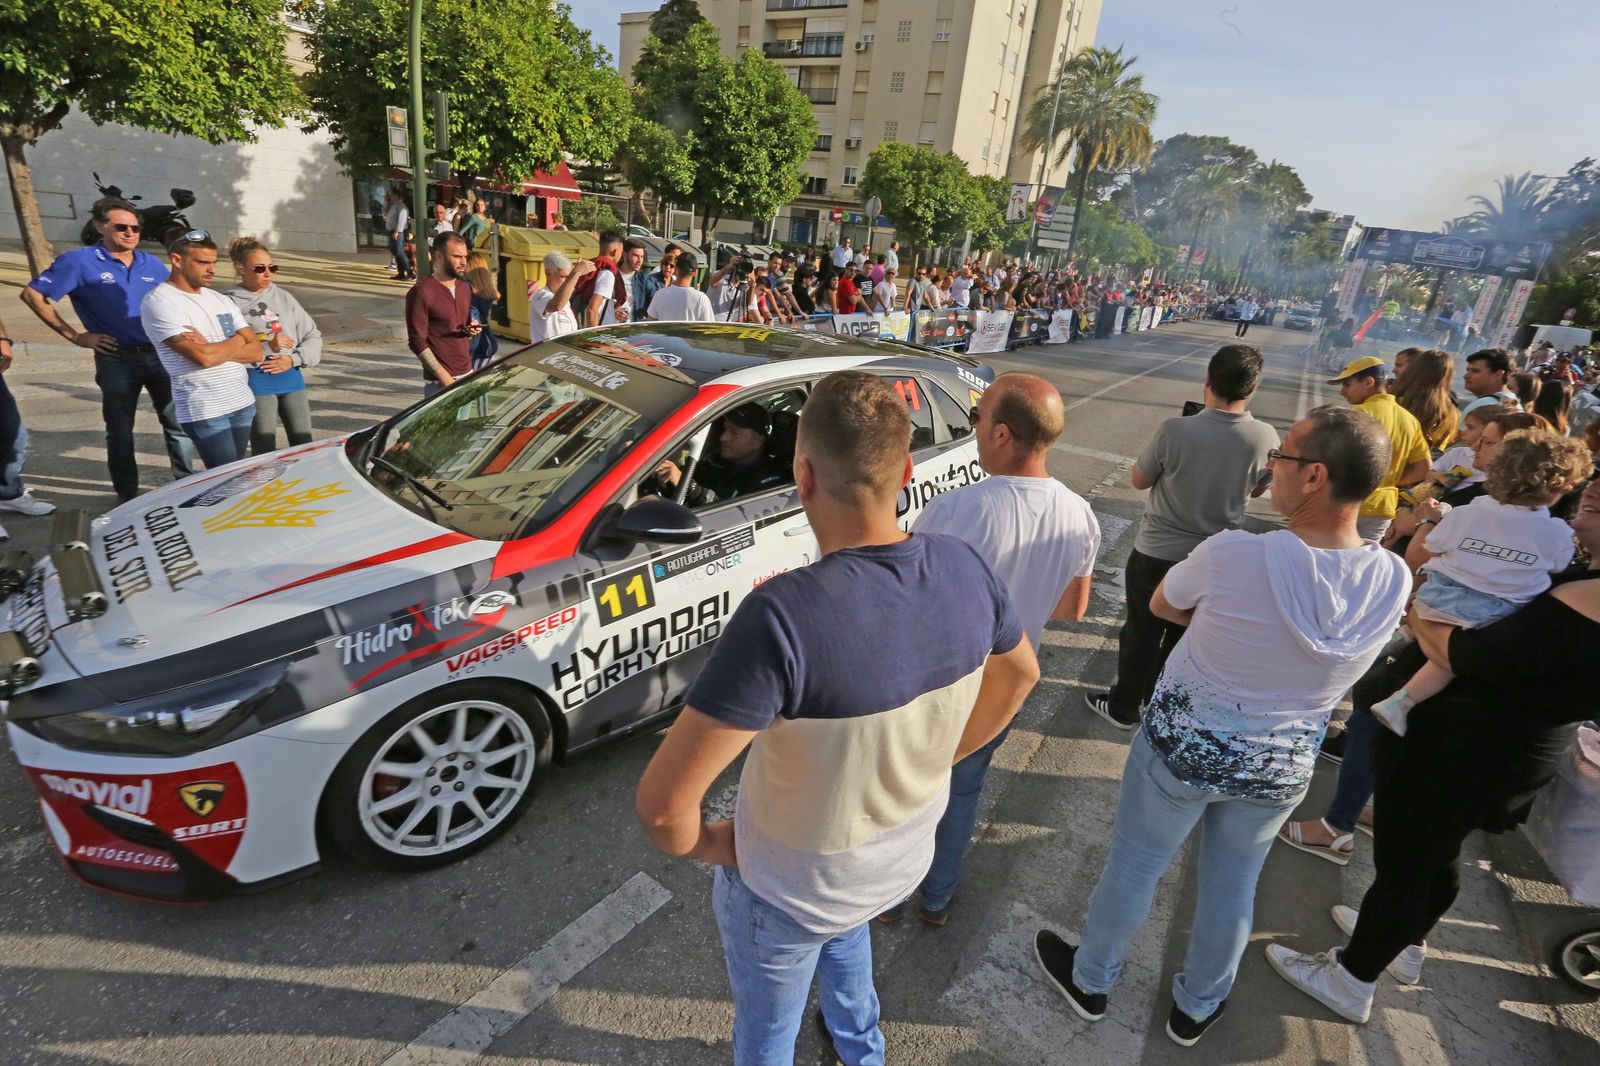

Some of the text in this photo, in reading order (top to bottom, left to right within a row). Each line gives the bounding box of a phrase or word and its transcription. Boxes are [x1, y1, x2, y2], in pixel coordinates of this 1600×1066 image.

[894, 377, 921, 411] 11
[896, 459, 988, 518] Diputac
[102, 524, 152, 605] DEL SUR
[144, 505, 204, 593] CAJA RURAL
[599, 574, 648, 618] 11
[446, 606, 577, 674] VAGSPEED
[447, 620, 577, 682] MOTORSPORT
[551, 590, 730, 692] HYUNDAI
[172, 818, 248, 839] SORT
